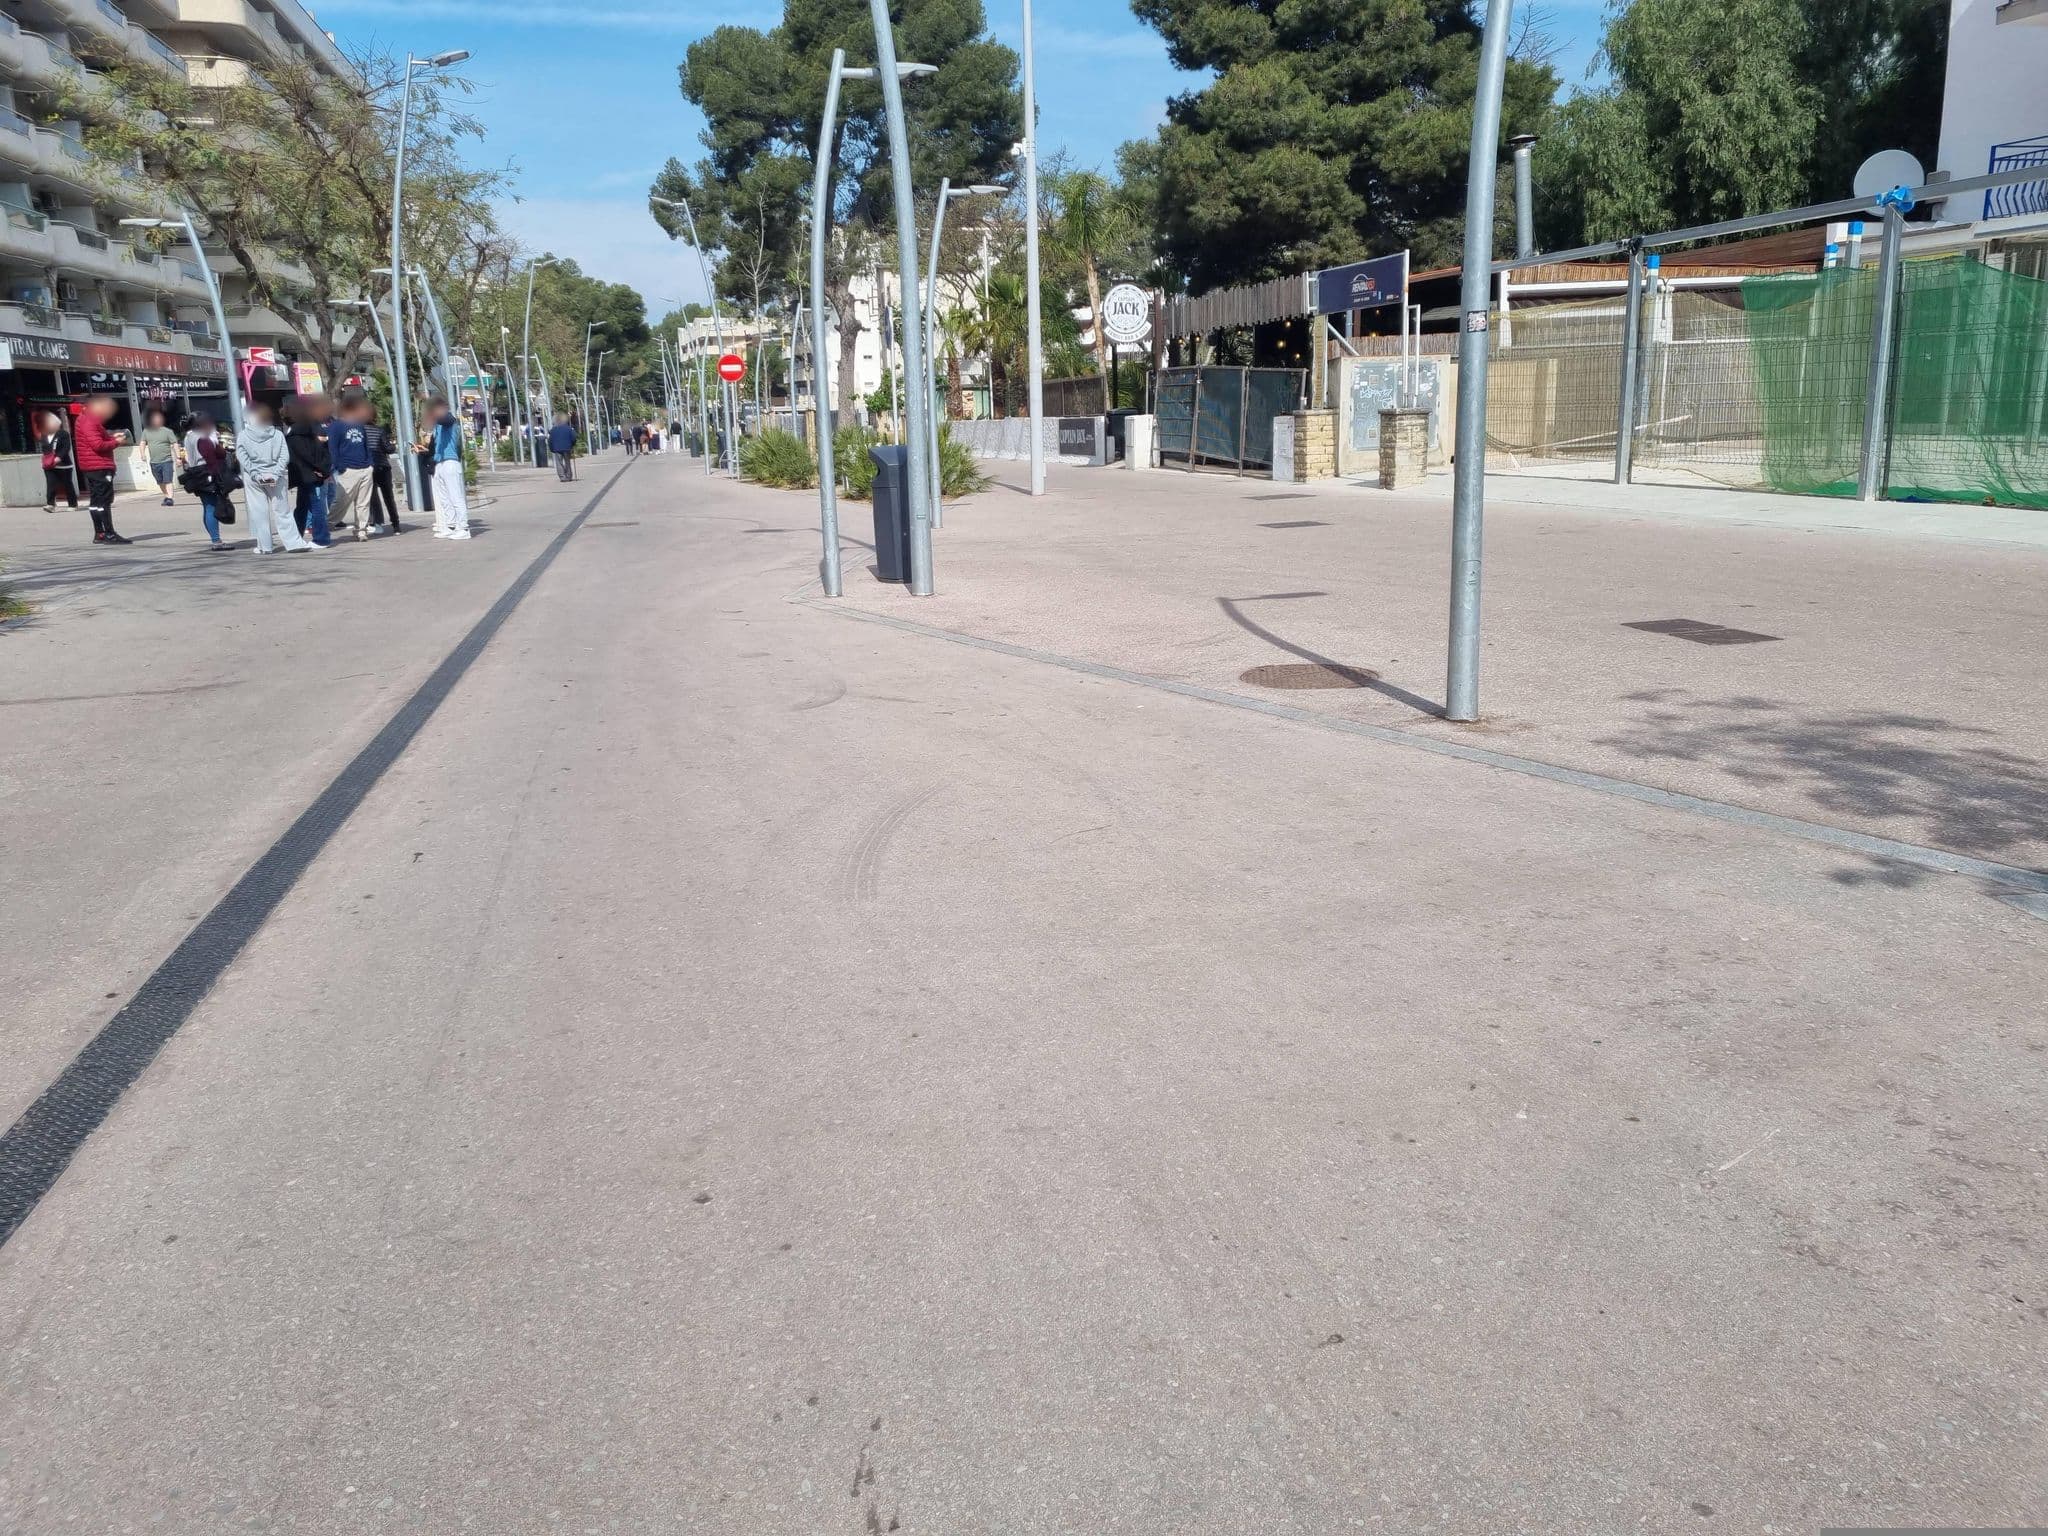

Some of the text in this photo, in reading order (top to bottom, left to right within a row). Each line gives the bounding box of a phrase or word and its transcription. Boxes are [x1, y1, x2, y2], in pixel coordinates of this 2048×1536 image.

[1113, 302, 1139, 316] JACK
[0, 336, 70, 360] NTRAL GAMES
